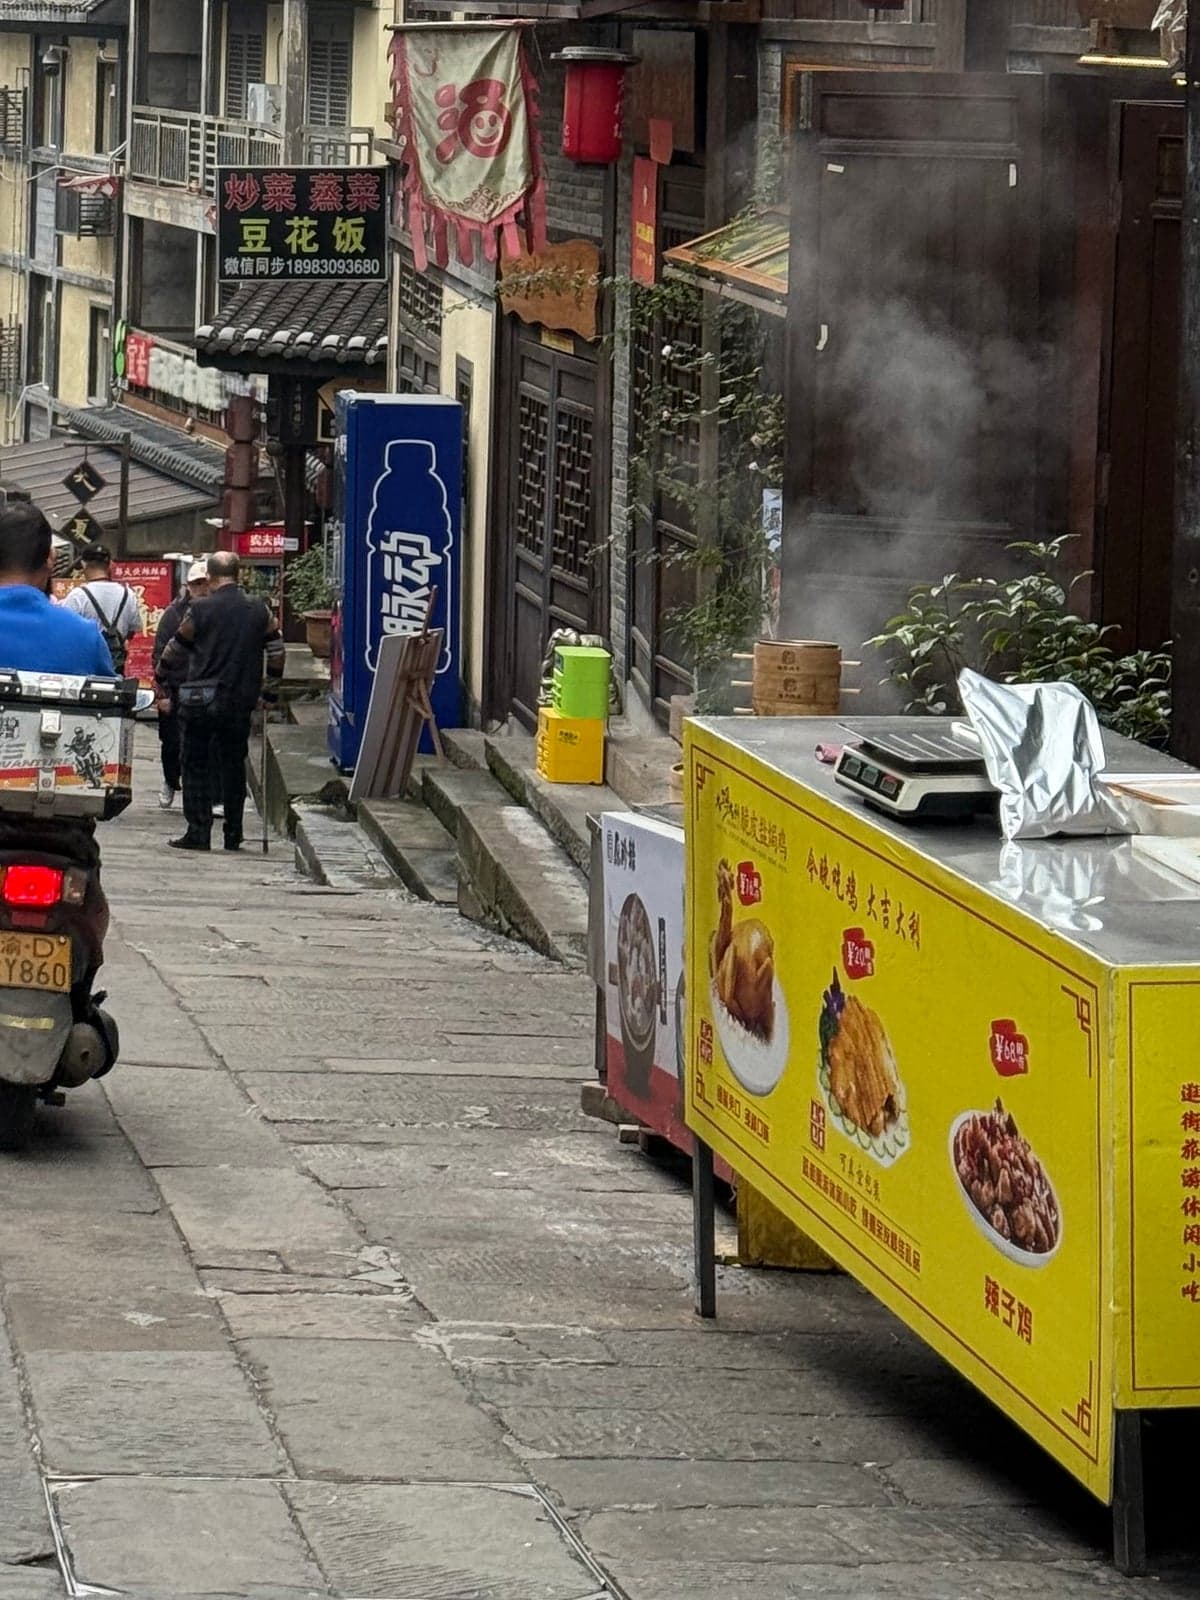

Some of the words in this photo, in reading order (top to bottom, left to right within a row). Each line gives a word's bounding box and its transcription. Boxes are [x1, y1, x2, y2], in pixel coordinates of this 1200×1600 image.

[224, 173, 297, 212] 炒菜
[308, 173, 380, 212] 蒸菜
[238, 216, 366, 254] 豆花饭
[224, 256, 380, 276] 微信同步18983093680
[867, 883, 920, 951] 大吉大利
[983, 1275, 1033, 1345] 辣子鸡
